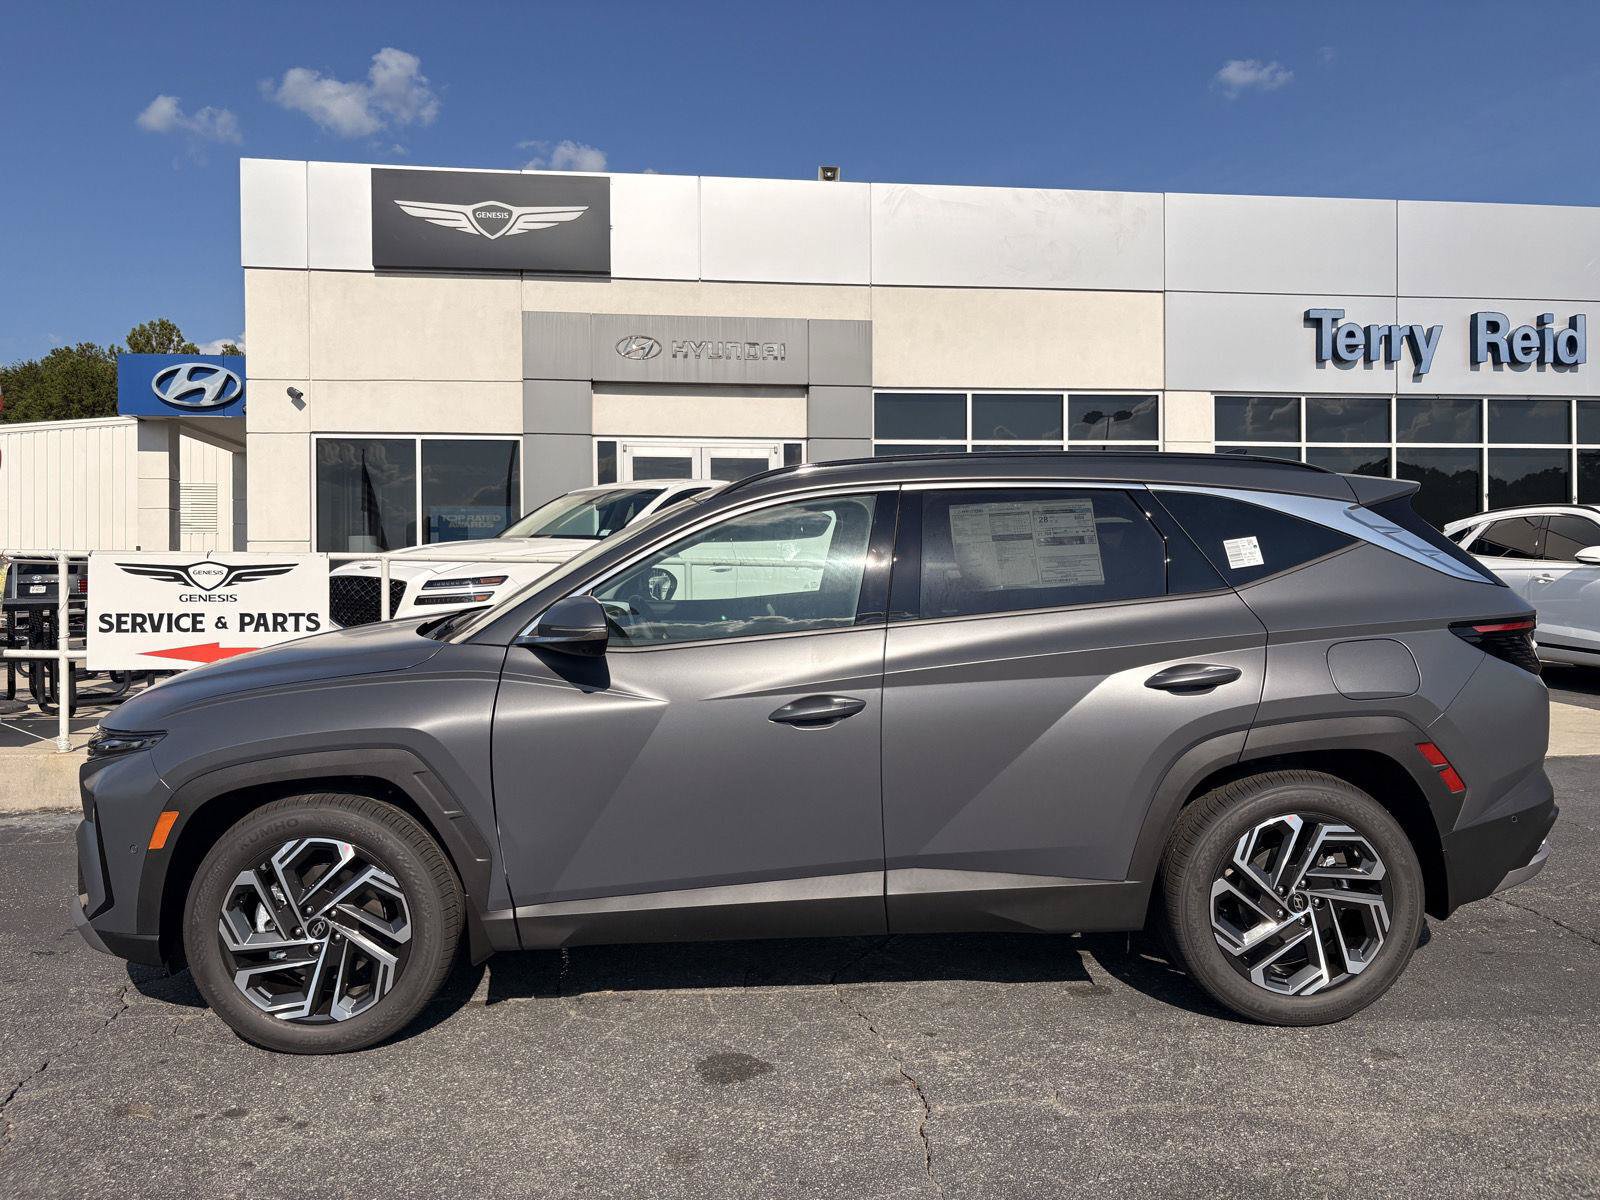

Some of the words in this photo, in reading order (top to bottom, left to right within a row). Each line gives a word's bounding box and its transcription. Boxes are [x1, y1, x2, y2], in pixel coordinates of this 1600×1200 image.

[475, 211, 509, 219] GENESIS
[1303, 308, 1443, 377] Terry
[1470, 311, 1586, 365] Reid
[672, 340, 785, 361] HYUNDAI
[192, 568, 224, 576] GENESIS
[178, 593, 238, 603] GENESIS
[98, 612, 206, 634] SERVICE
[214, 615, 229, 630] &
[238, 612, 321, 633] PARTS
